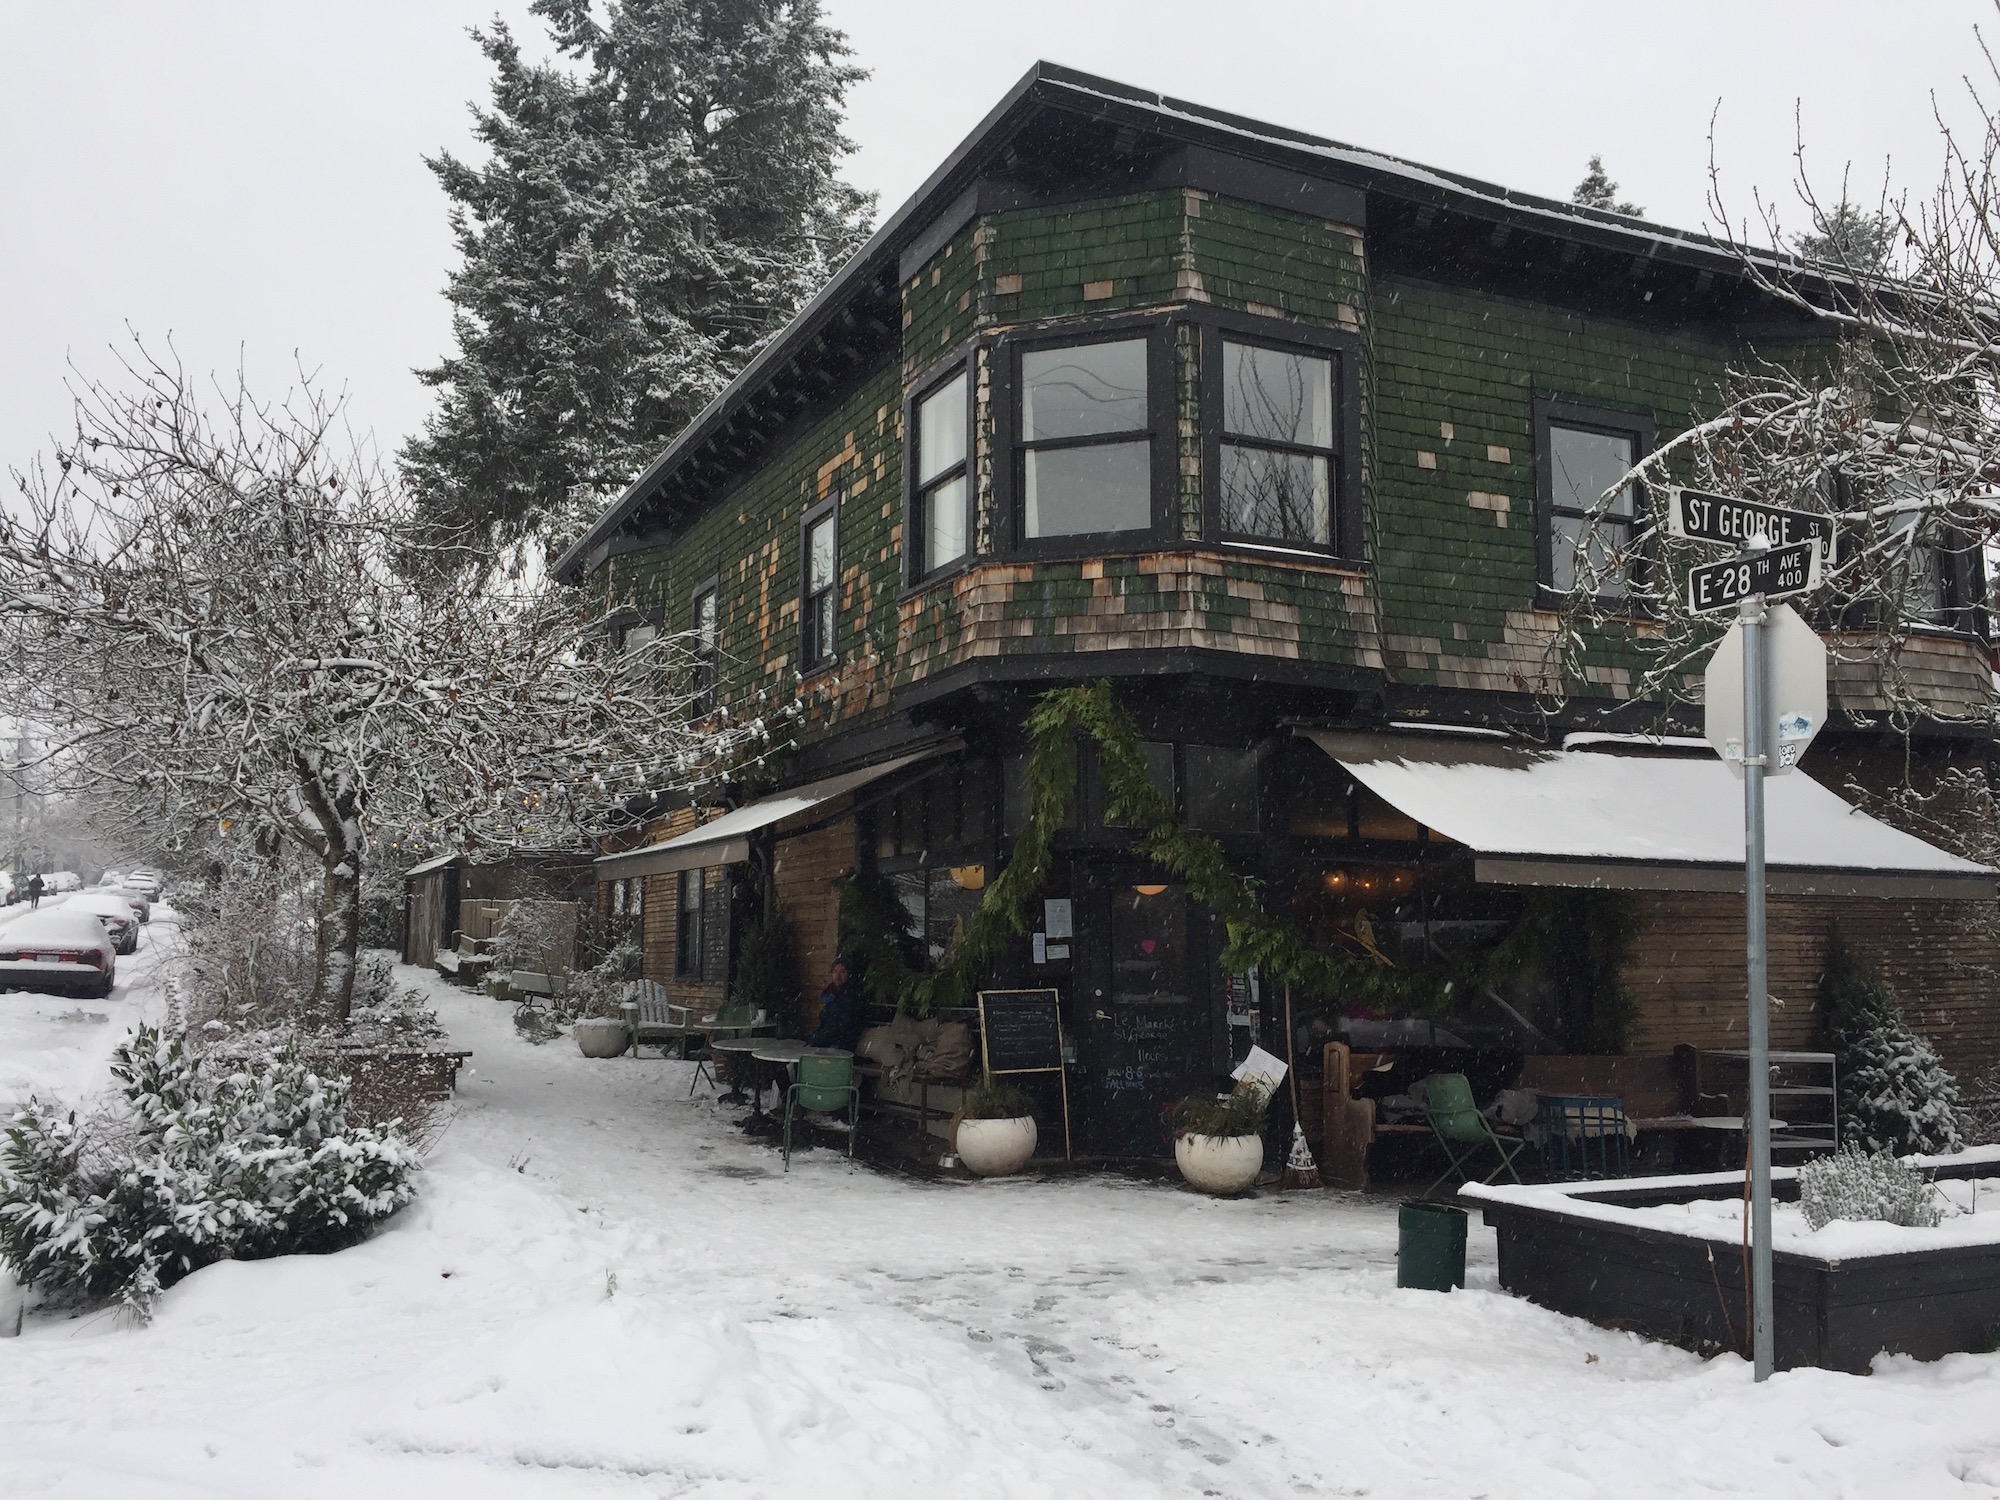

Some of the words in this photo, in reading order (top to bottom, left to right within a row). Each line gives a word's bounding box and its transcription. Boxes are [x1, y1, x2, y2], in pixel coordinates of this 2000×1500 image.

[1688, 499, 1712, 532] ST
[1718, 504, 1792, 546] GEORGE
[1809, 521, 1820, 537] ST
[1700, 573, 1713, 604] E
[1779, 551, 1801, 571] AVE
[1777, 569, 1802, 588] 400
